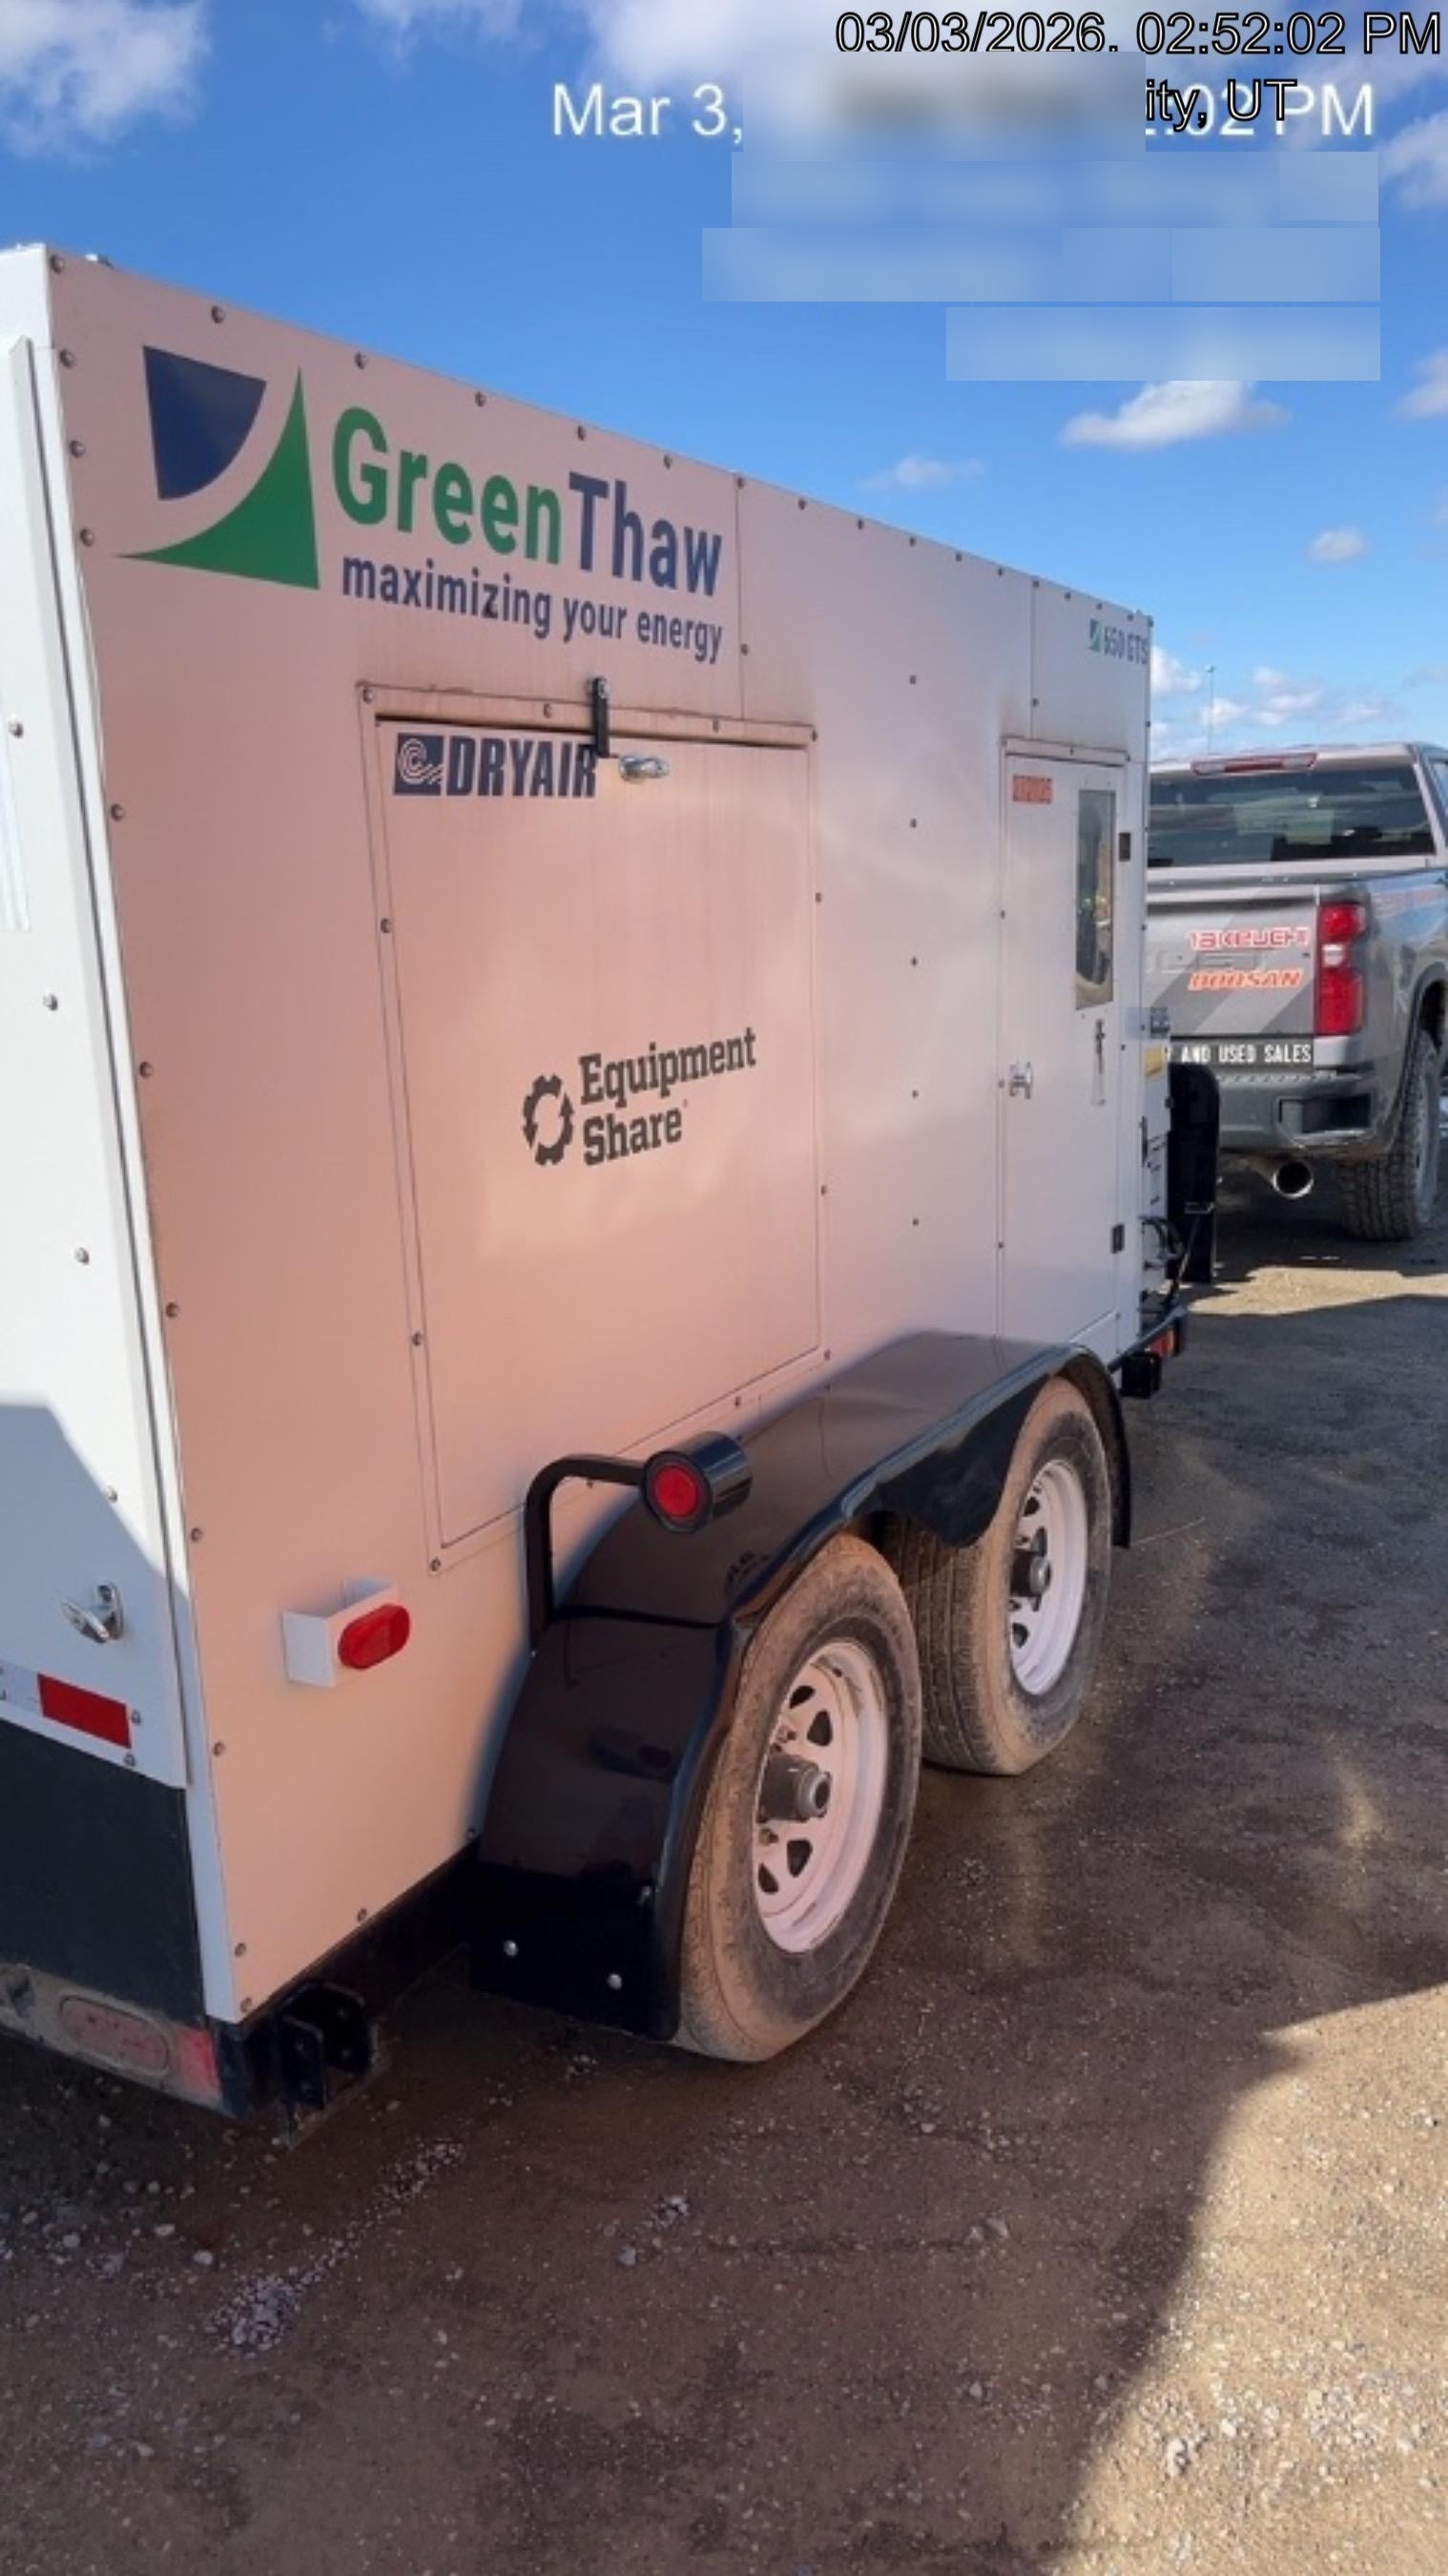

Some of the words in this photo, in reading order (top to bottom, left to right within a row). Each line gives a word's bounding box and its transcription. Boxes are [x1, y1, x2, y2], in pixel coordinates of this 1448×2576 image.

[332, 405, 723, 597] GreenThaw
[341, 554, 552, 640] maximizing
[562, 597, 628, 643] your
[637, 613, 723, 666] energy
[446, 735, 598, 798] DRYAIR
[578, 1027, 756, 1109] Equipment
[1181, 1044, 1211, 1064] AND
[1218, 1043, 1258, 1064] USED
[1263, 1042, 1312, 1064] SALES
[583, 1107, 683, 1167] Share
